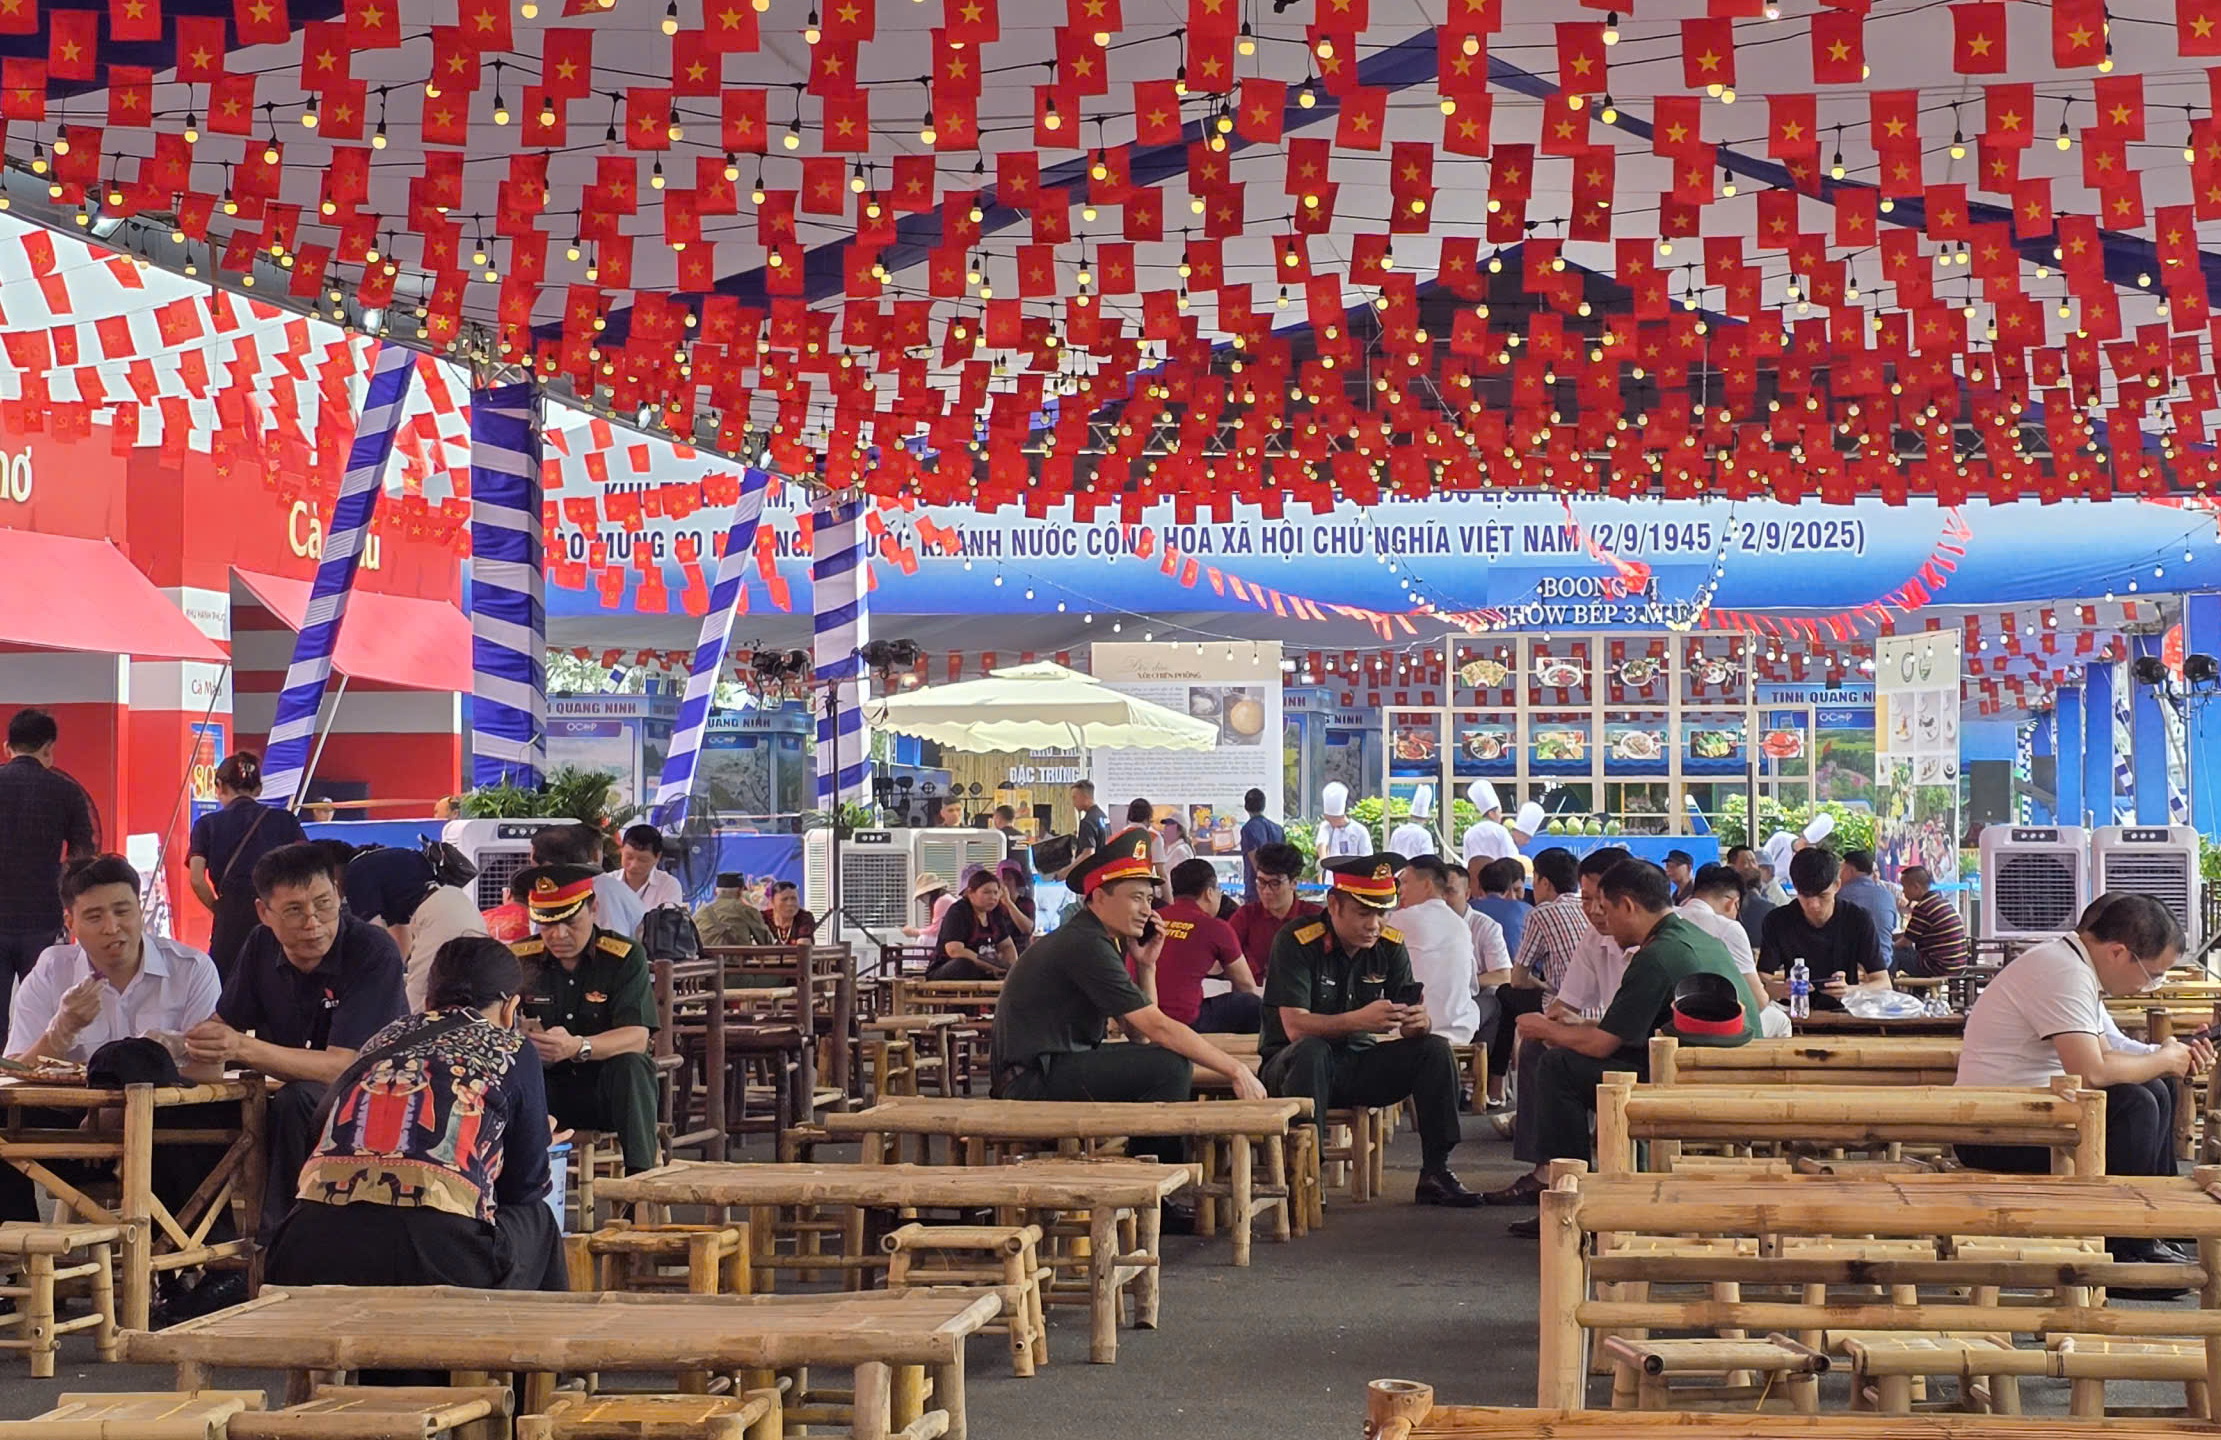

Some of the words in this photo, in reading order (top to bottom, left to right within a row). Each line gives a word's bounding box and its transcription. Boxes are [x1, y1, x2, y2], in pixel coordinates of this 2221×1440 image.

[289, 501, 322, 560] Cà
[921, 522, 1002, 556] KÁNH
[1012, 521, 1077, 557] NƯỚC
[1222, 519, 1250, 554] XÃ
[1262, 519, 1303, 560] HỘI
[1313, 517, 1364, 554] CHỦ
[1375, 519, 1450, 553] NGHĨA
[1459, 518, 1514, 560] VIỆT
[1523, 525, 1580, 553] NAM
[1591, 522, 1712, 555] (2/9/1945
[1742, 520, 1866, 555] 2/9/2025)
[1543, 576, 1628, 598] BOONG
[1574, 598, 1618, 624] BẾP
[1624, 604, 1637, 624] 3
[605, 702, 637, 714] NINH
[707, 718, 739, 728] UANG
[743, 718, 771, 728] NINH
[1334, 714, 1363, 725] NINH
